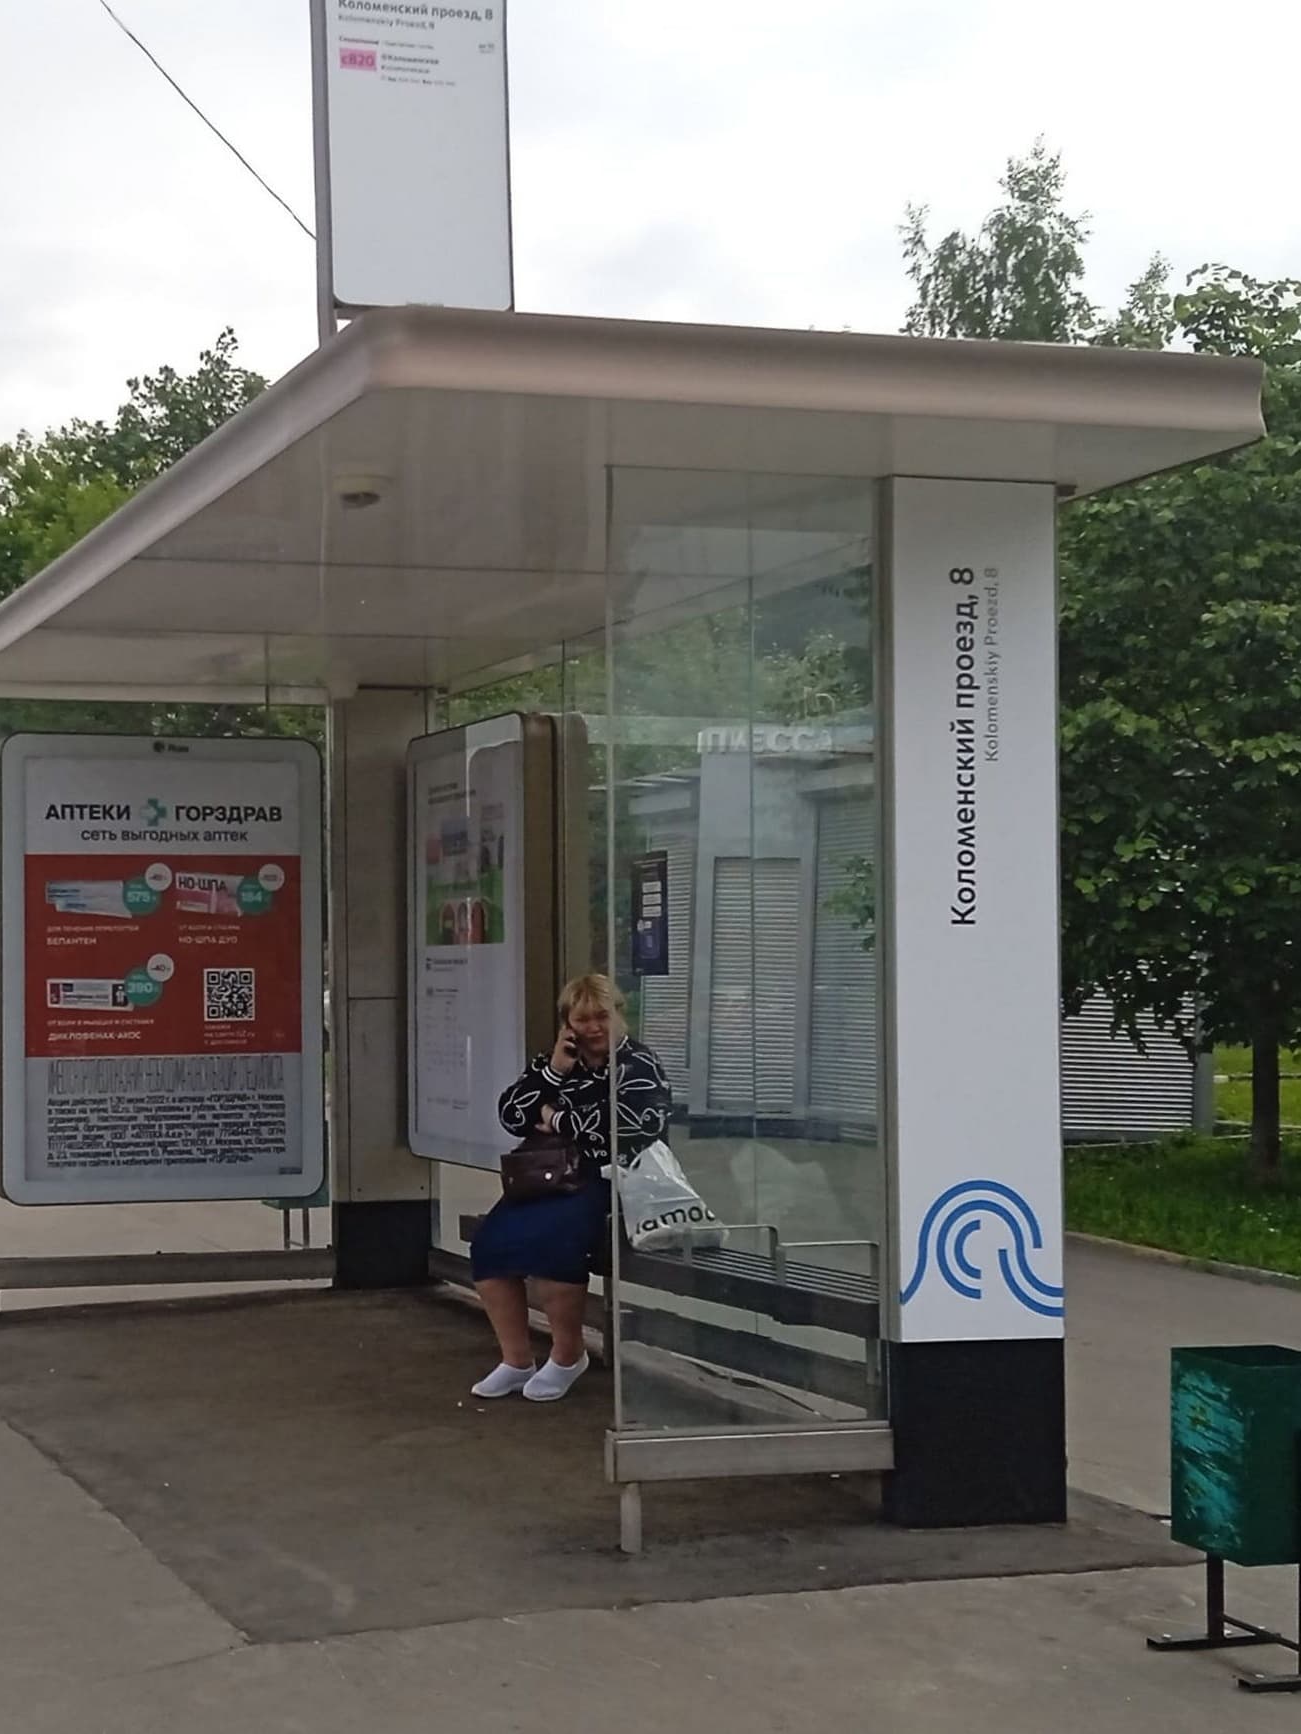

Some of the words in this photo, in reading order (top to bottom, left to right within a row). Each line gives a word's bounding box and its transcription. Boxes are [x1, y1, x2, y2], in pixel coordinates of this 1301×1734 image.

[338, 0, 428, 15] Коломенский
[949, 567, 975, 585] 8
[984, 567, 998, 578] 8
[984, 583, 1000, 646] Proezd,
[955, 594, 980, 708] проезд,
[984, 652, 1002, 762] Kolomenskiy
[45, 804, 130, 820] АПТЕКИ
[175, 805, 282, 824] ГОРЗДРАВ
[950, 719, 976, 925] Коломенский
[81, 830, 117, 841] сеть
[121, 829, 199, 843] выгодных
[203, 829, 249, 842] аптек
